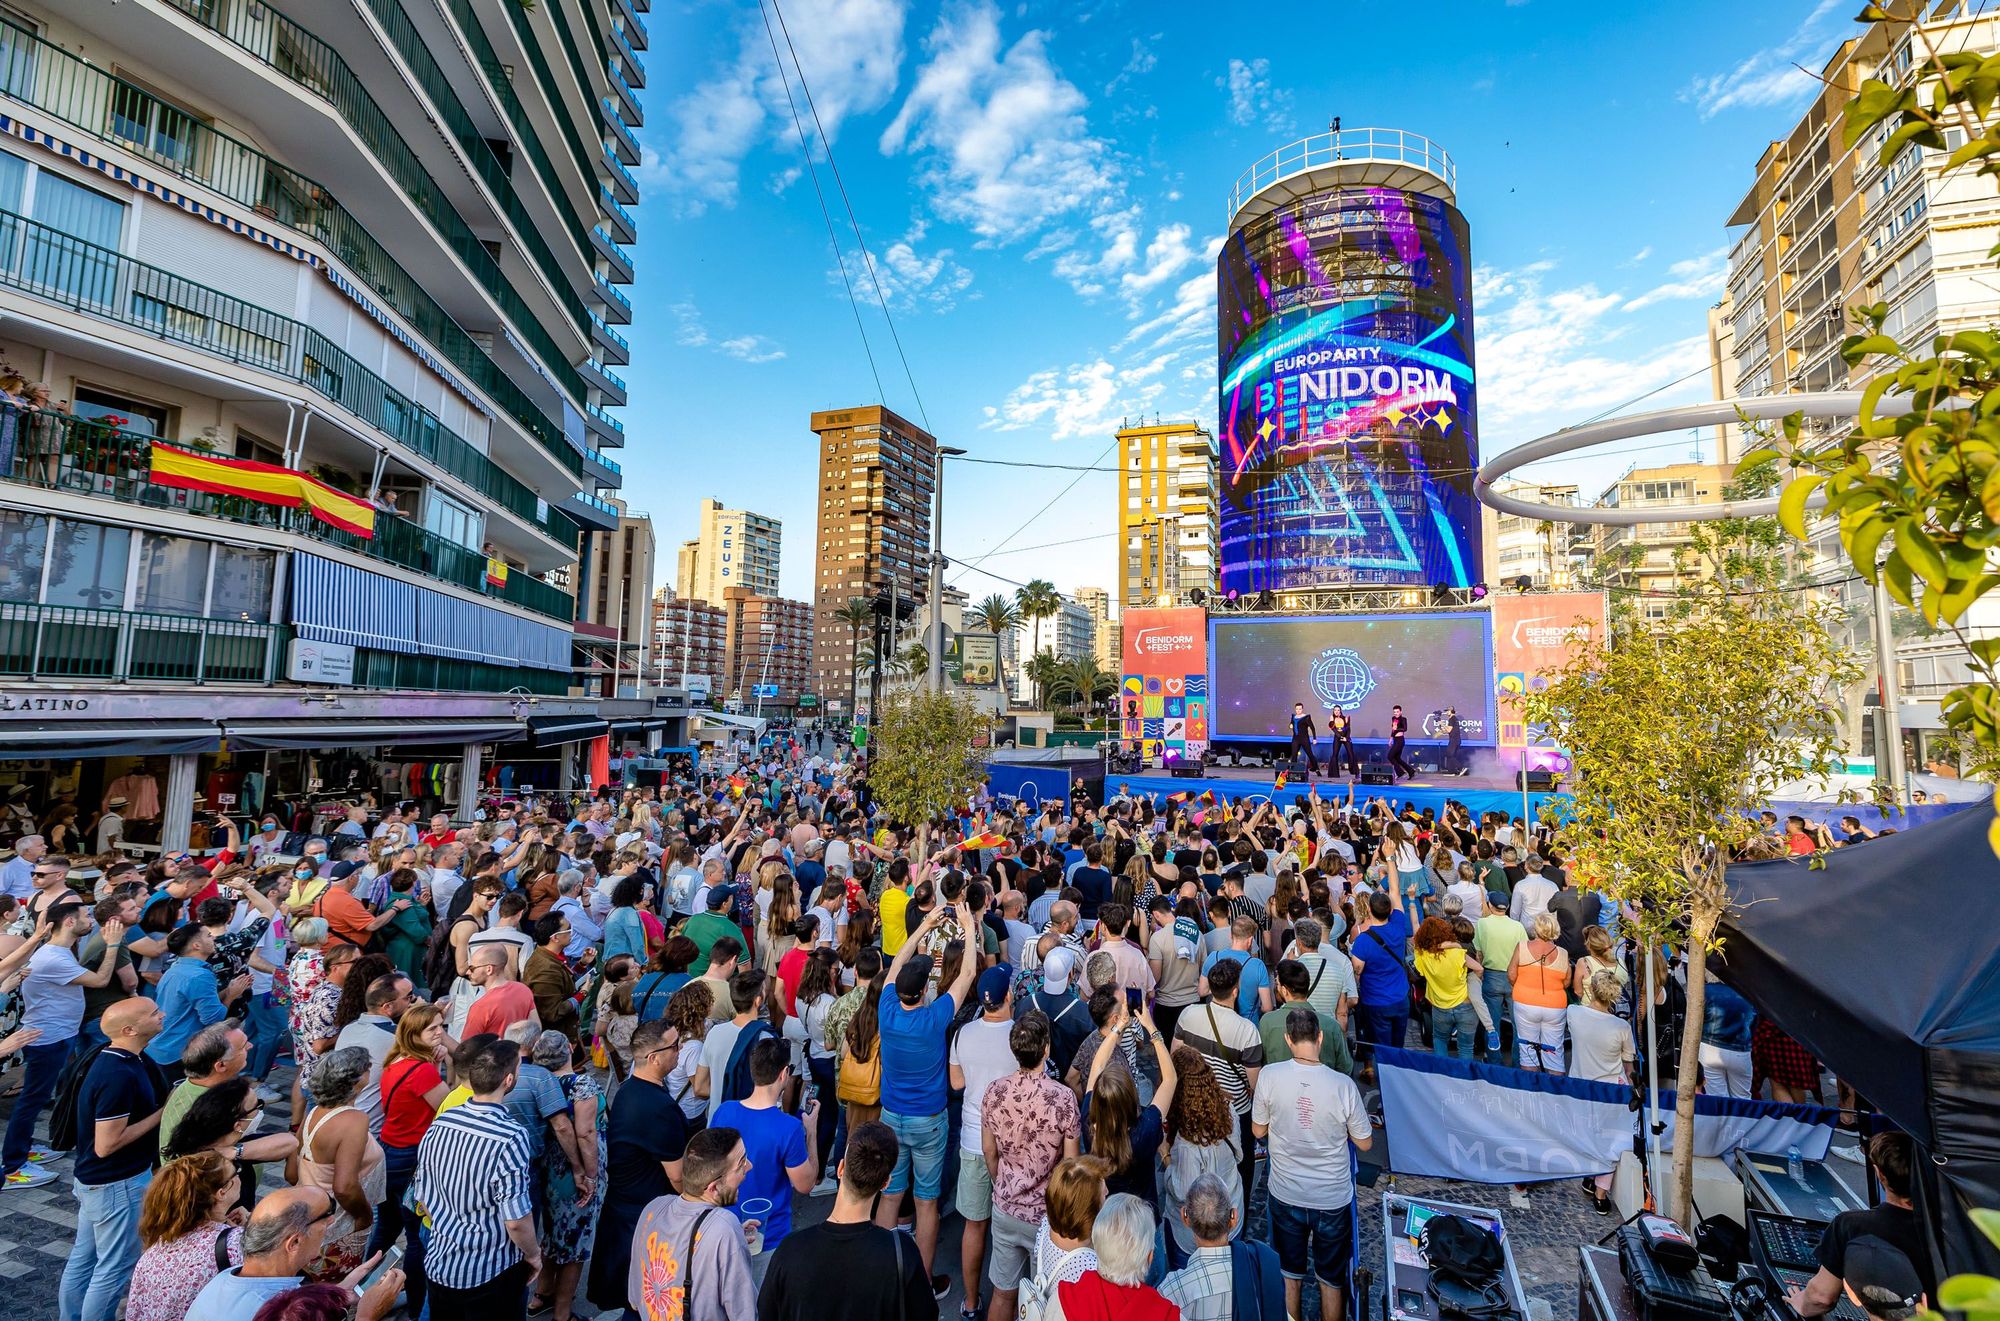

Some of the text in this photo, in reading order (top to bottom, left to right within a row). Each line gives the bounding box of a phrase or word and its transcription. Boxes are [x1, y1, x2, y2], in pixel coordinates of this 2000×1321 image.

[1274, 346, 1381, 373] EUROPARTY
[1255, 364, 1456, 414] BENIDORM
[722, 525, 733, 577] ZEUS
[1526, 626, 1589, 637] BENIDOM
[1145, 635, 1193, 644] BENIDORM
[1534, 636, 1562, 645] FEST
[1151, 643, 1174, 651] FEST
[1321, 648, 1359, 658] MARTA
[302, 660, 313, 669] BV
[3, 699, 89, 711] LATINO
